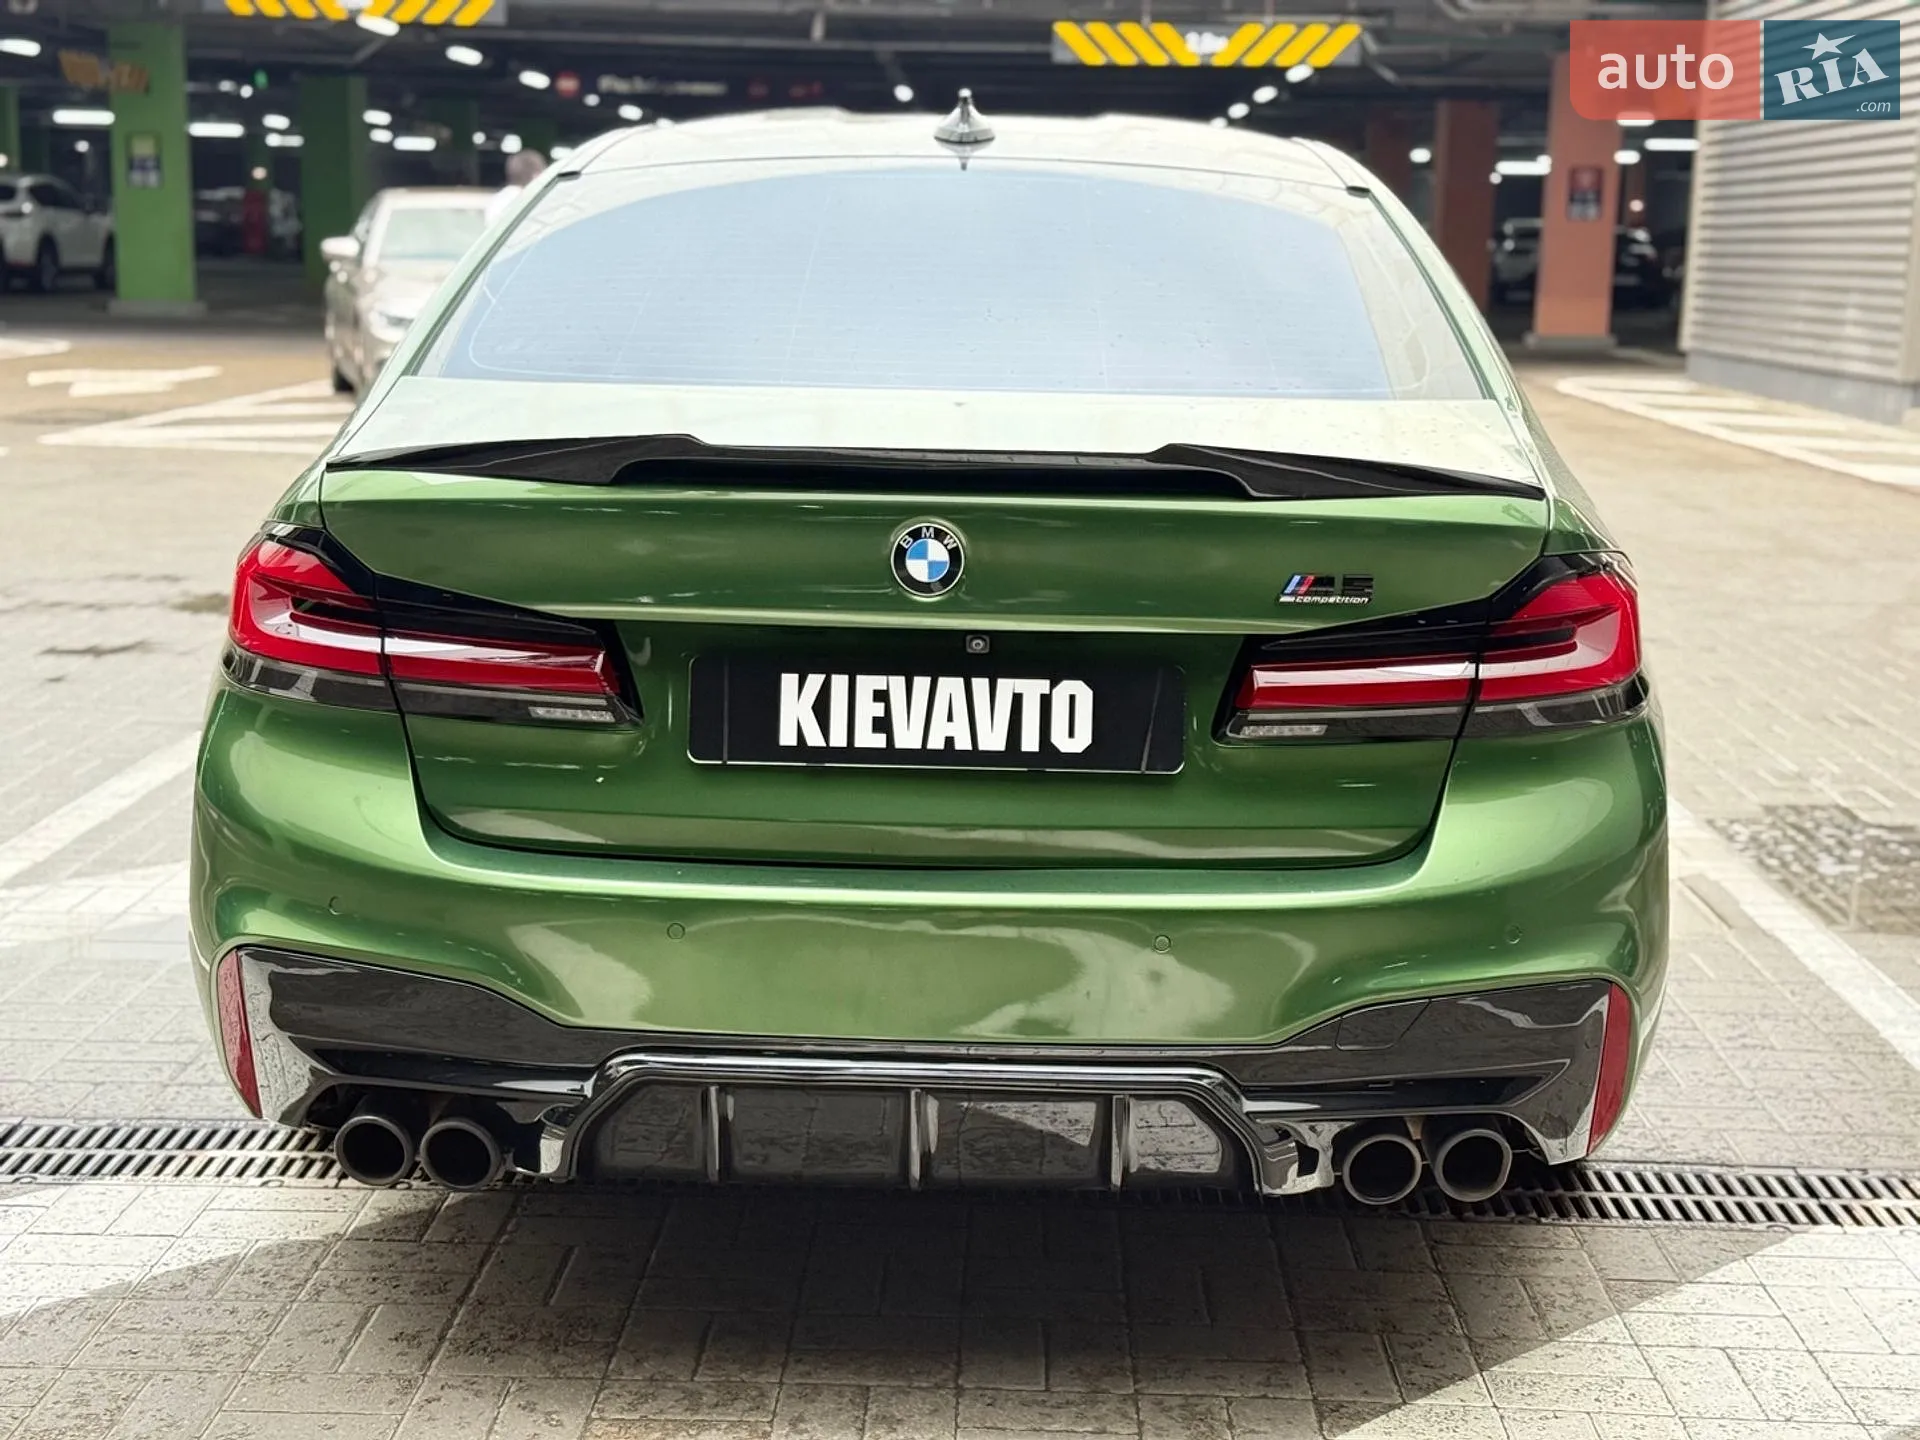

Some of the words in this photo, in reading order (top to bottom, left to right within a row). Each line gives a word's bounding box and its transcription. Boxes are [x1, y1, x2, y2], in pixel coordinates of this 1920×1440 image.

[900, 527, 957, 550] BMW
[1296, 595, 1369, 605] competition
[779, 673, 1093, 753] KIEVAVTO
